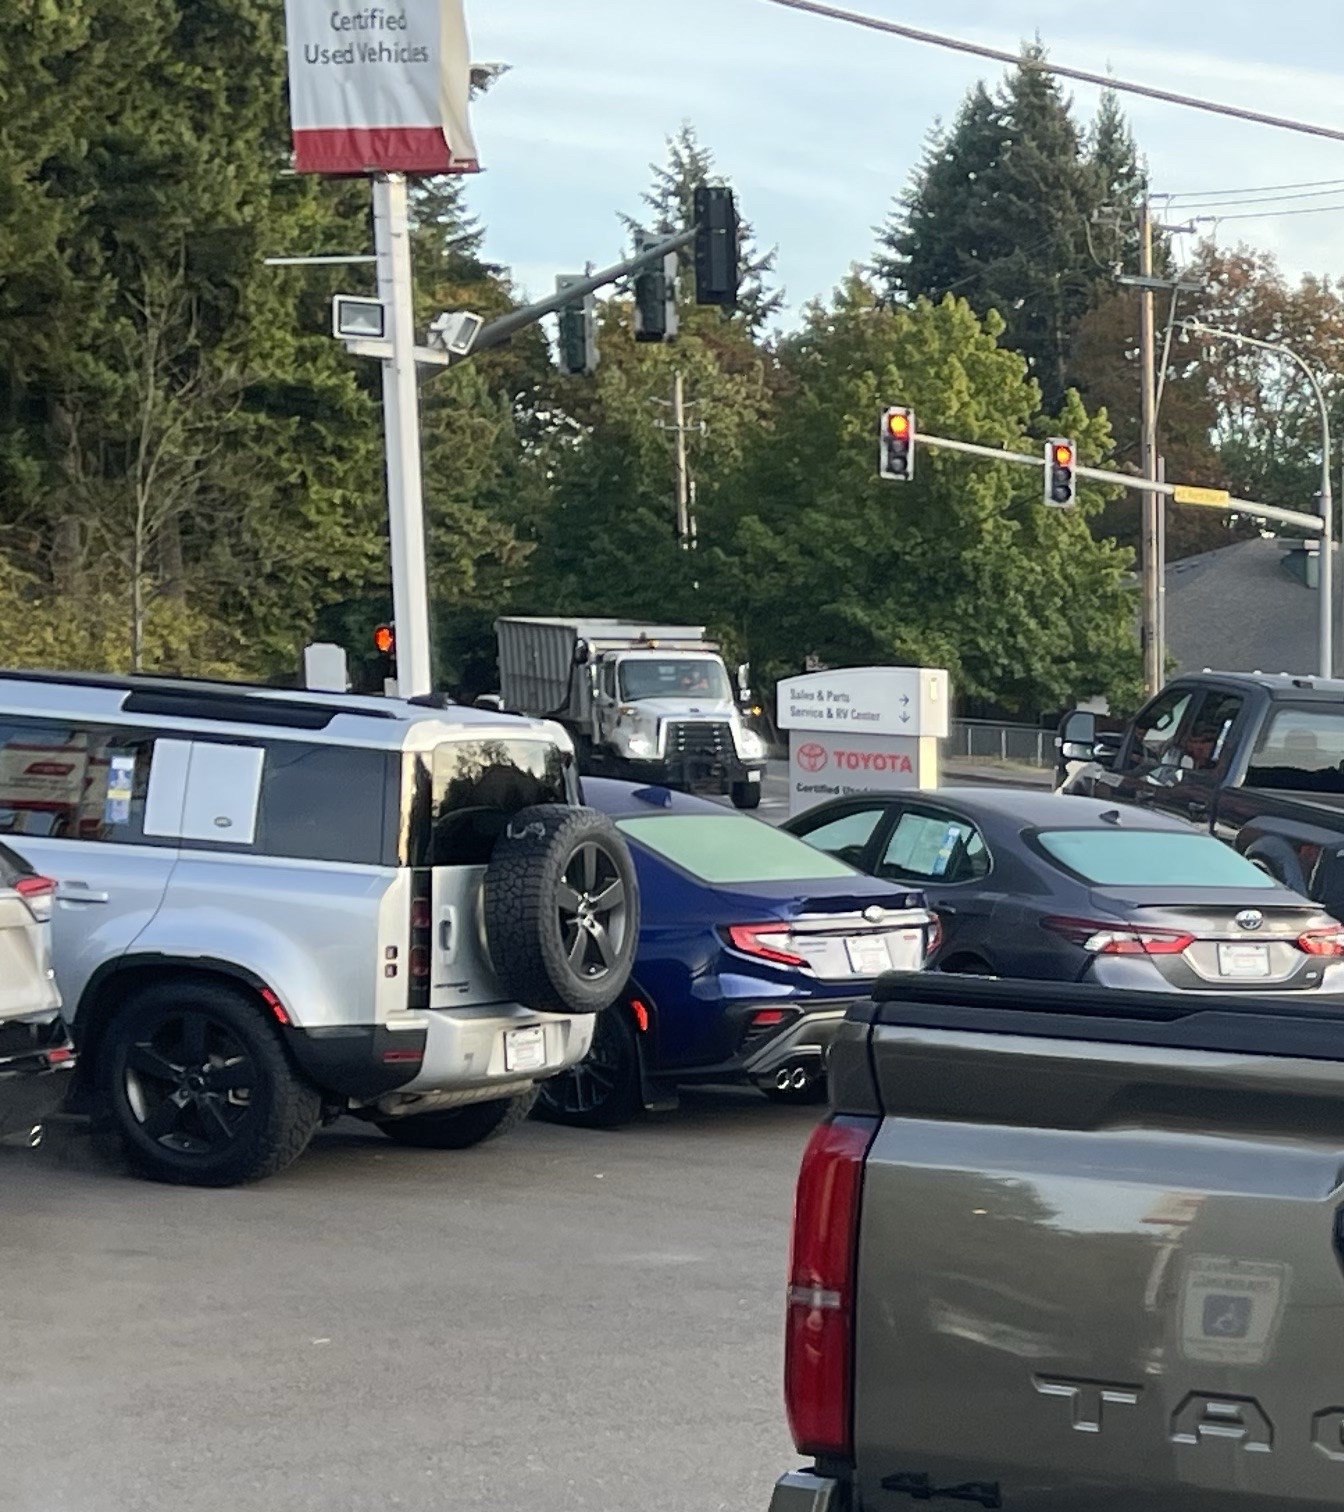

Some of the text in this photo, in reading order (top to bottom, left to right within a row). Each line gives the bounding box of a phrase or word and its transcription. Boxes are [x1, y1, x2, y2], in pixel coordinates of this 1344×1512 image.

[330, 7, 408, 32] Certified
[304, 41, 429, 64] Used Vehicles
[790, 688, 815, 700] Sales
[790, 705, 824, 719] Service
[826, 707, 834, 719] &
[833, 750, 914, 774] TOYOTA
